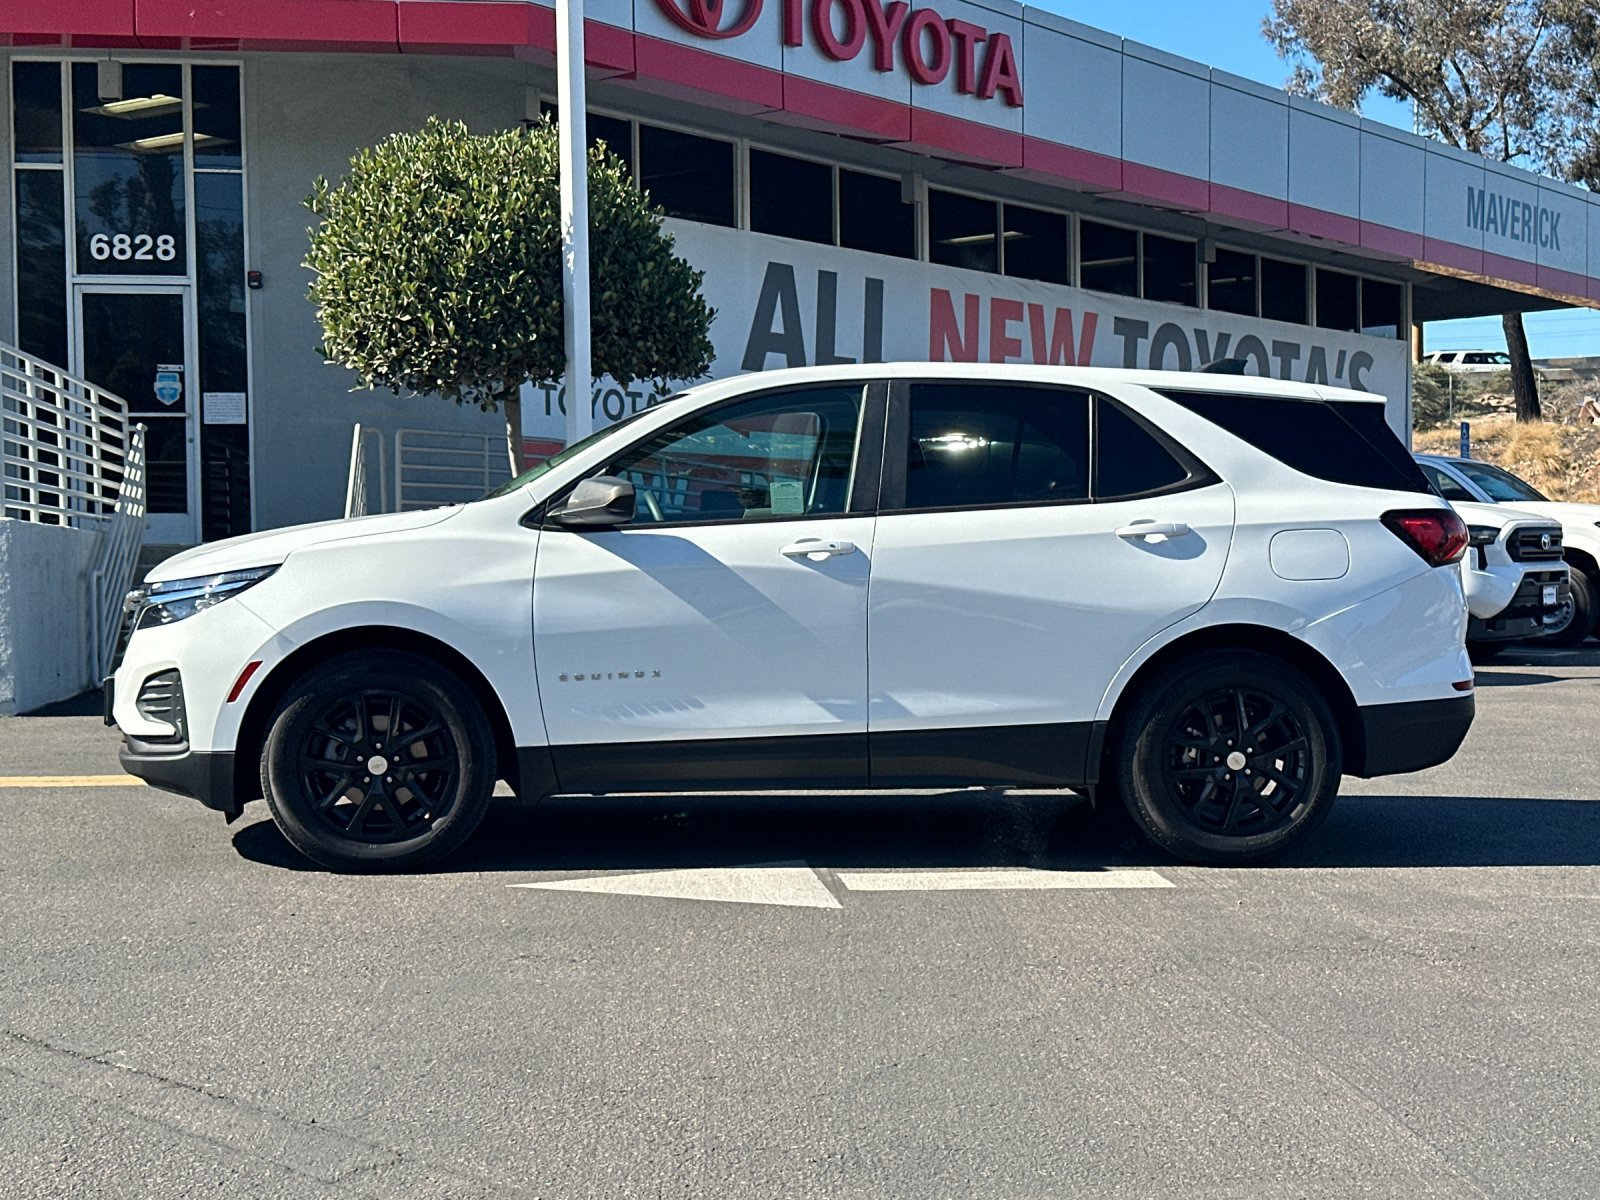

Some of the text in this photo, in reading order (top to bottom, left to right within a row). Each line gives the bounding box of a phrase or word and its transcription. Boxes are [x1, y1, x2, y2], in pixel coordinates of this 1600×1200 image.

[1466, 186, 1560, 251] MAVERICK
[90, 233, 176, 261] 6828
[741, 261, 888, 372] ALL
[929, 287, 1099, 366] NEW
[559, 669, 661, 682] EQUINOX
